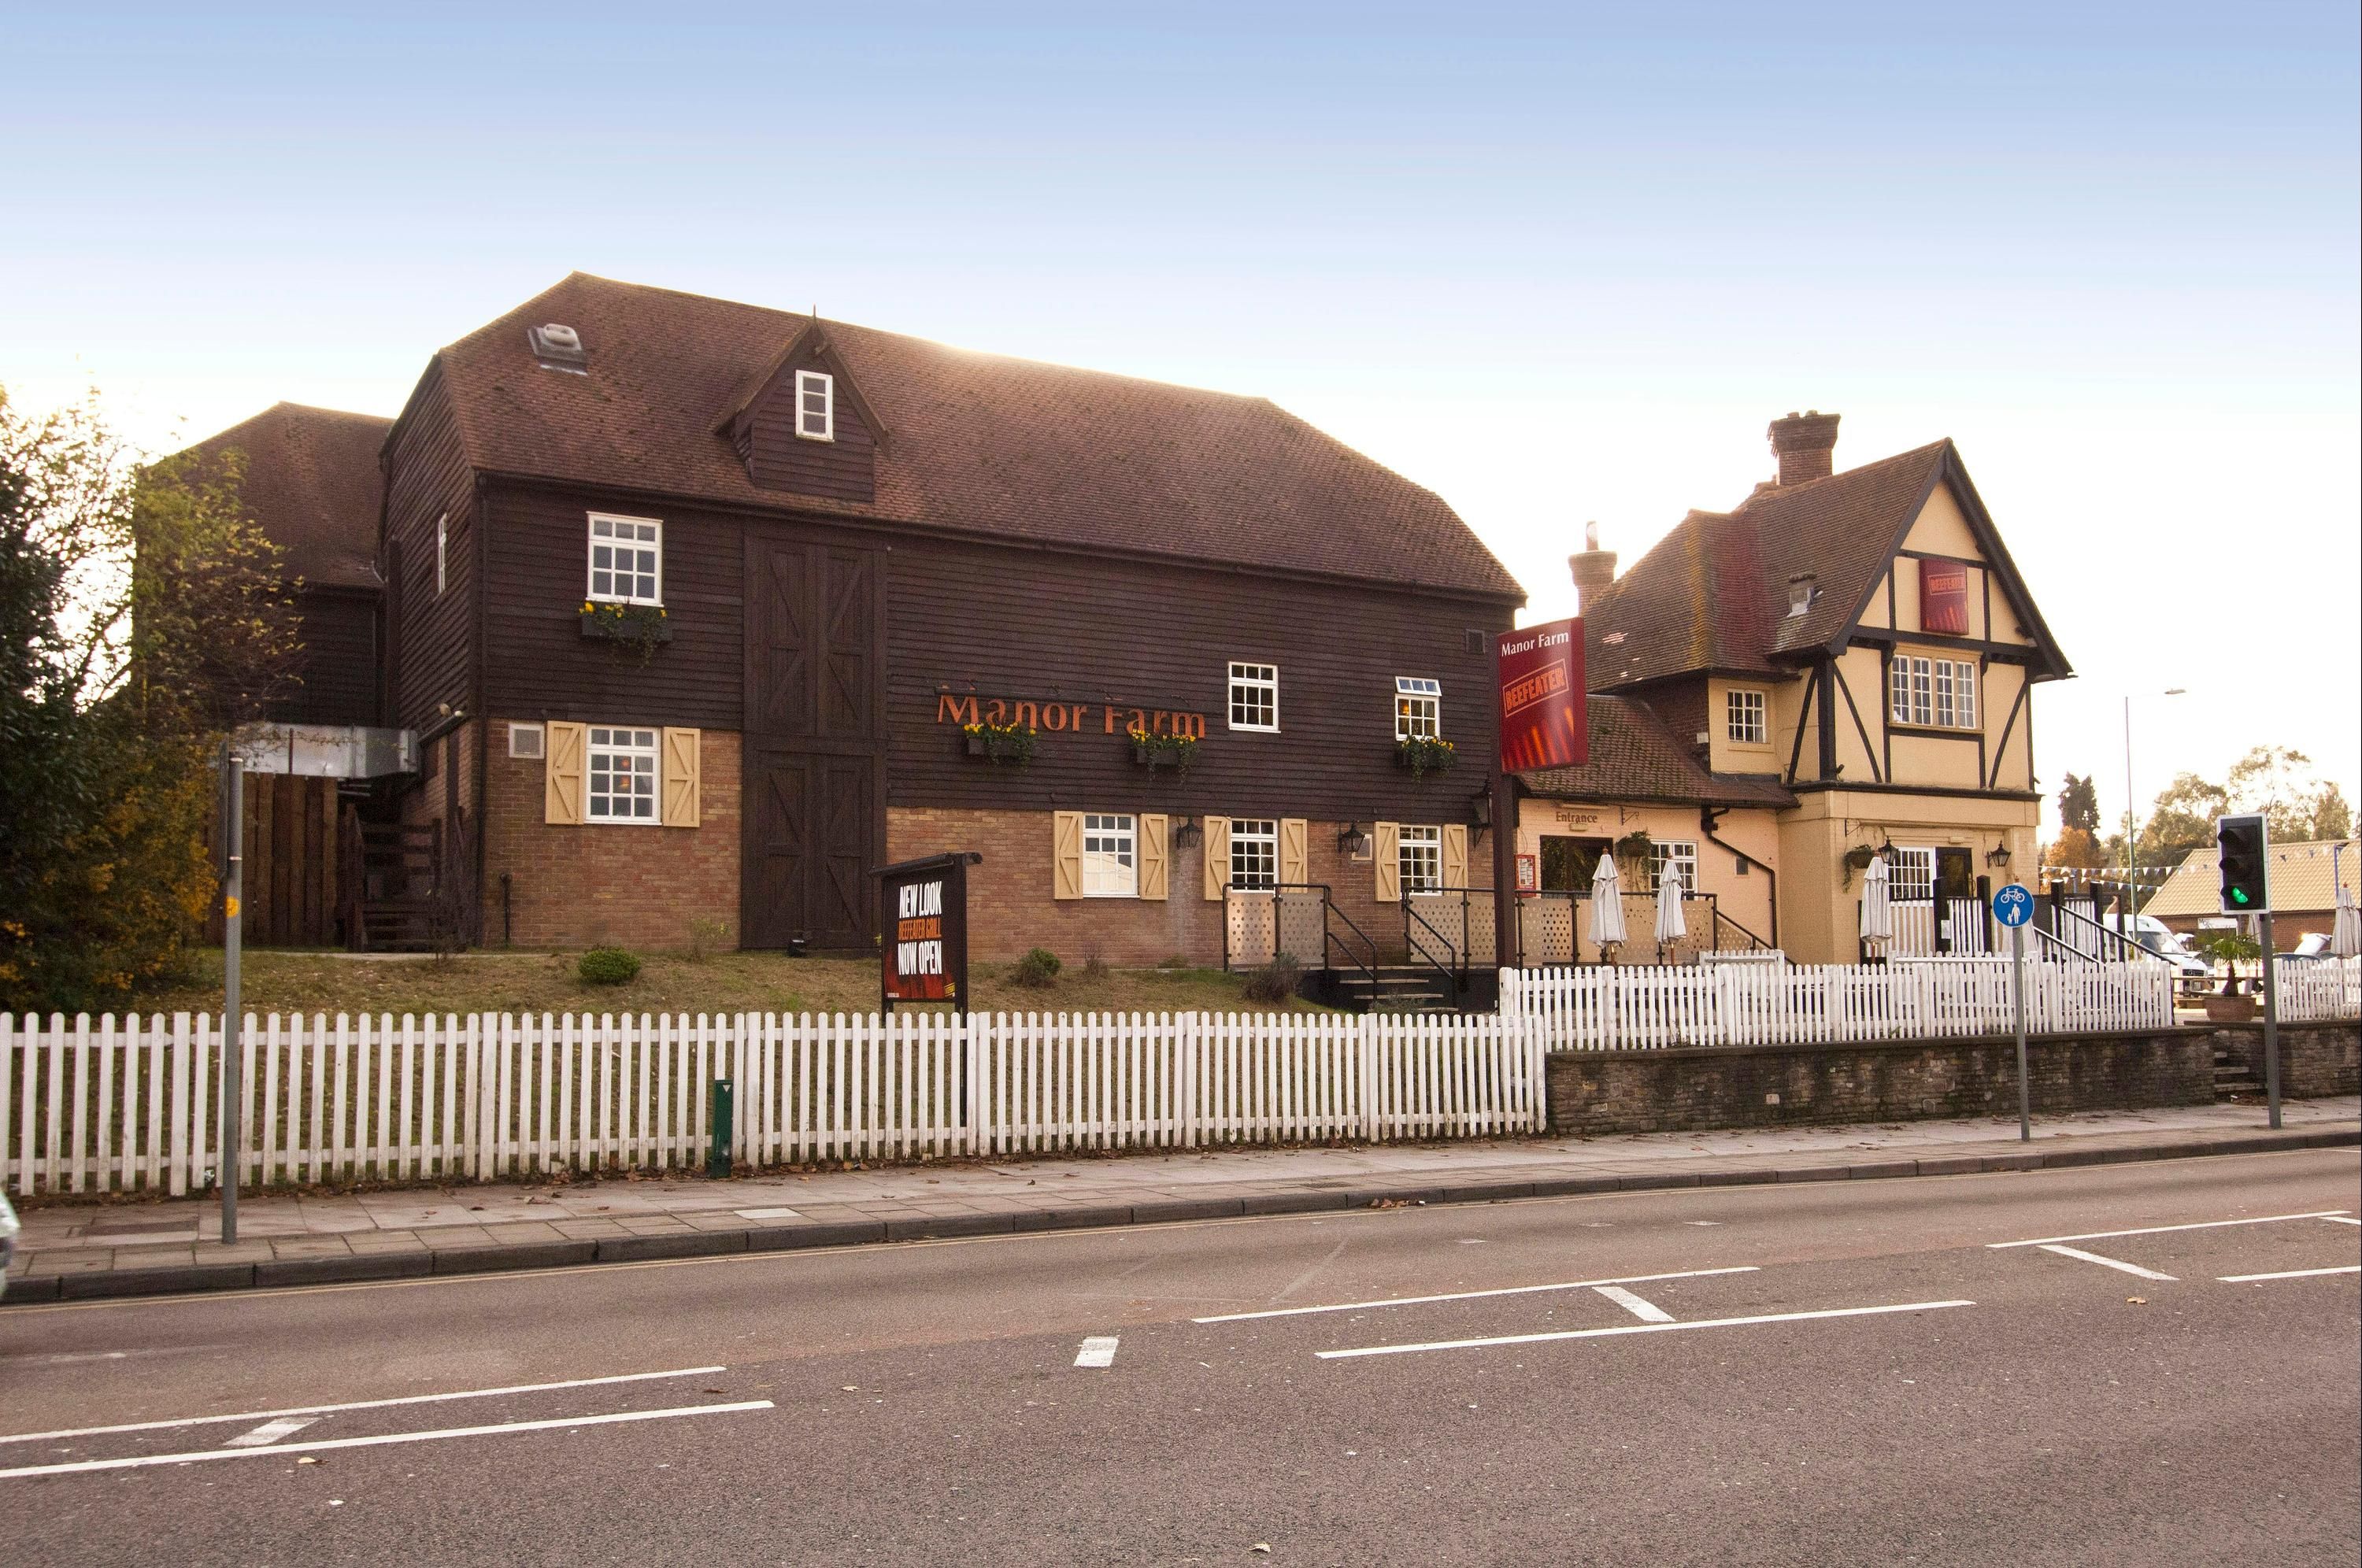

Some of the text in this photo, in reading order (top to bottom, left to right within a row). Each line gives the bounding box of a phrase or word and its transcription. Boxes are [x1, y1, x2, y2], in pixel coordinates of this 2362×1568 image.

[1501, 632, 1569, 657] Manor Farm
[1505, 668, 1565, 710] BEEFEATER
[937, 684, 1205, 738] Manor Farm
[1556, 812, 1597, 823] Entrance
[899, 881, 942, 919] NEW LOOK
[898, 917, 942, 941] BEEFEATER GRILL
[898, 941, 942, 975] NOW OPEN
